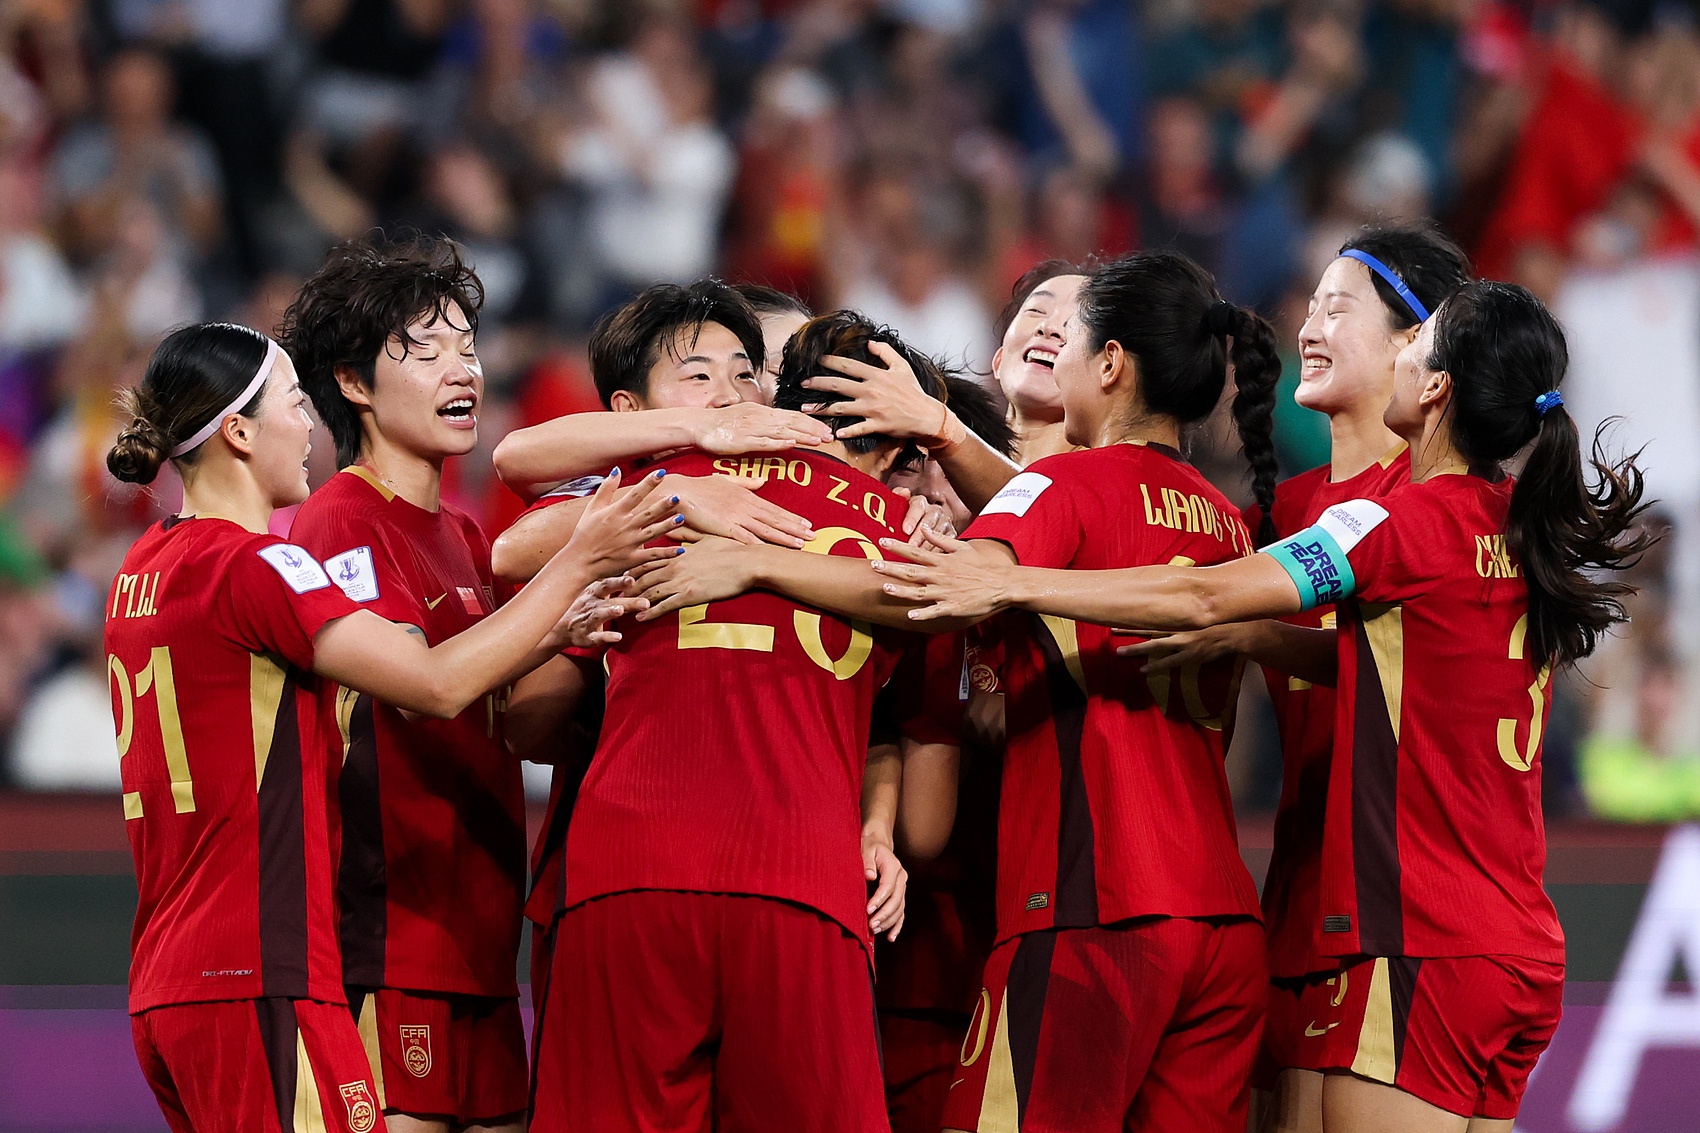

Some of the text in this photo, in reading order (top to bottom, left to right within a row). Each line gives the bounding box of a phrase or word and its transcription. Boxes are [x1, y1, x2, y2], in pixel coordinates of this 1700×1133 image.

[712, 457, 812, 487] SHAO
[1140, 484, 1223, 542] WANG
[1327, 509, 1362, 536] FEARLESS
[1336, 508, 1362, 528] DREAM
[1475, 535, 1526, 578] CHE
[111, 571, 160, 618] M.W.
[402, 1029, 427, 1038] CFA
[342, 1084, 365, 1098] CFA
